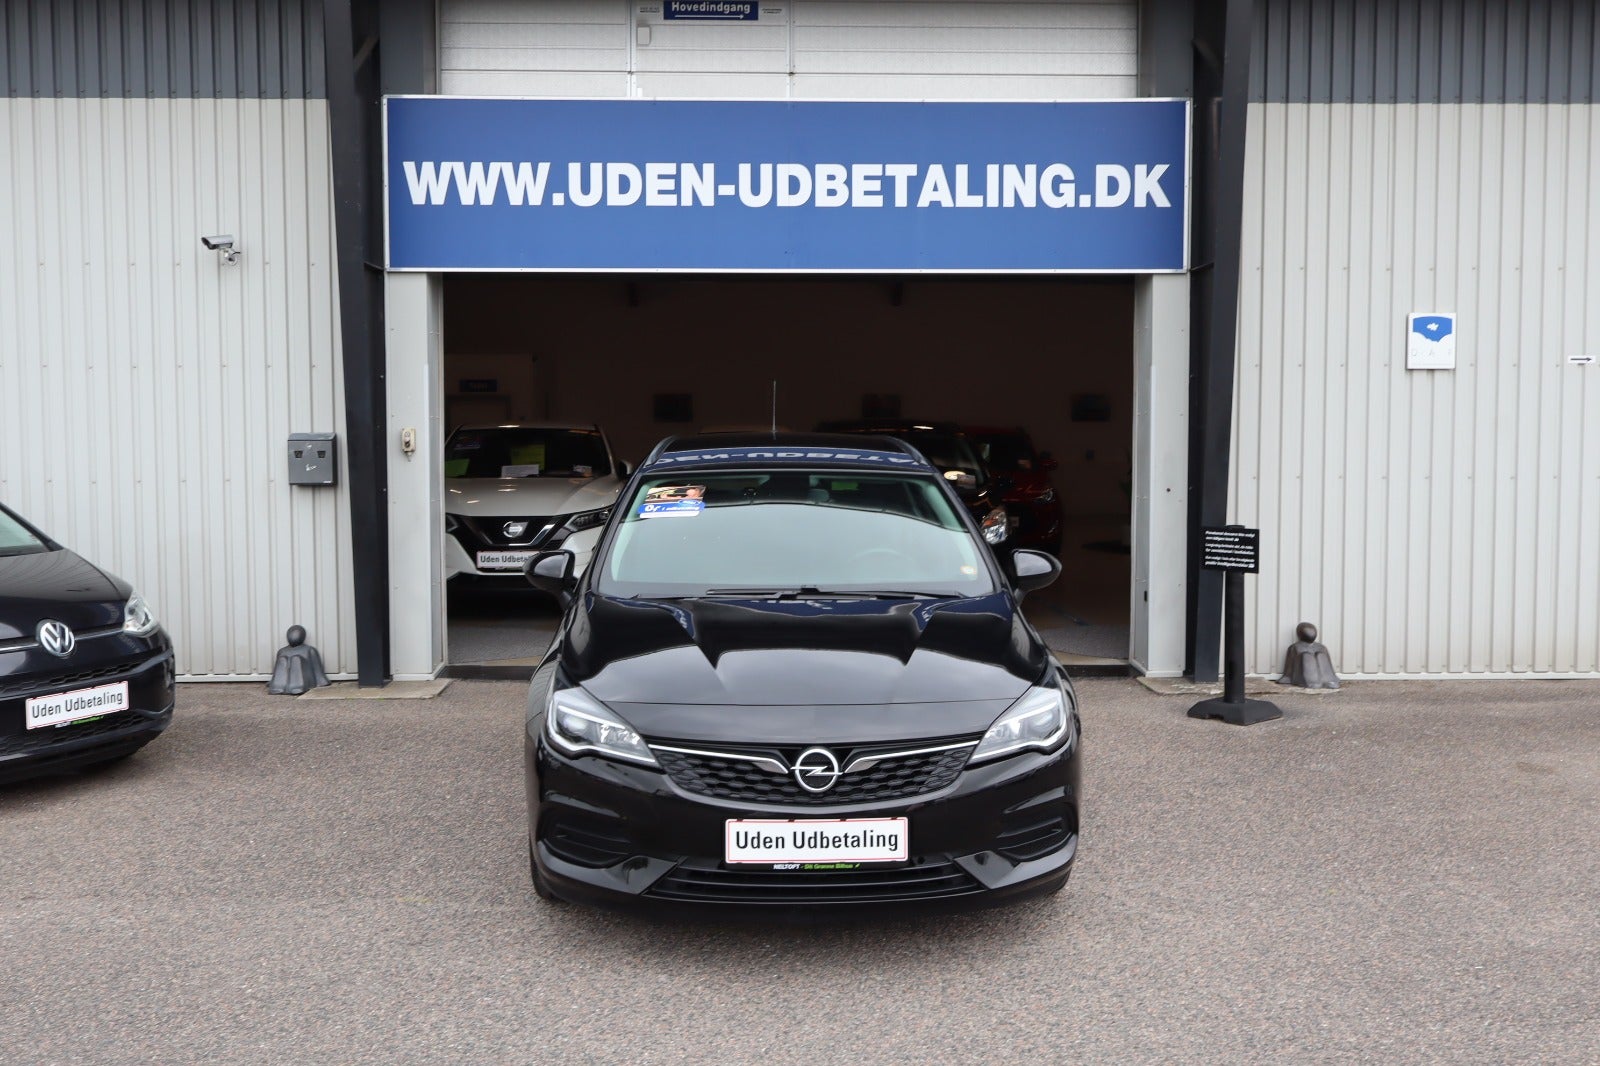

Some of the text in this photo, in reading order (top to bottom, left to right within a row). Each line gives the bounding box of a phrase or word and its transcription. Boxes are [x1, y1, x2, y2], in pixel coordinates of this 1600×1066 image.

[672, 1, 751, 14] Hovedindgang
[402, 161, 1171, 209] WWW.UDEN-UDBETALING.DK
[480, 555, 500, 563] Uden
[32, 691, 123, 719] Uden Udbetaling
[736, 829, 899, 851] Uden Udbetaling
